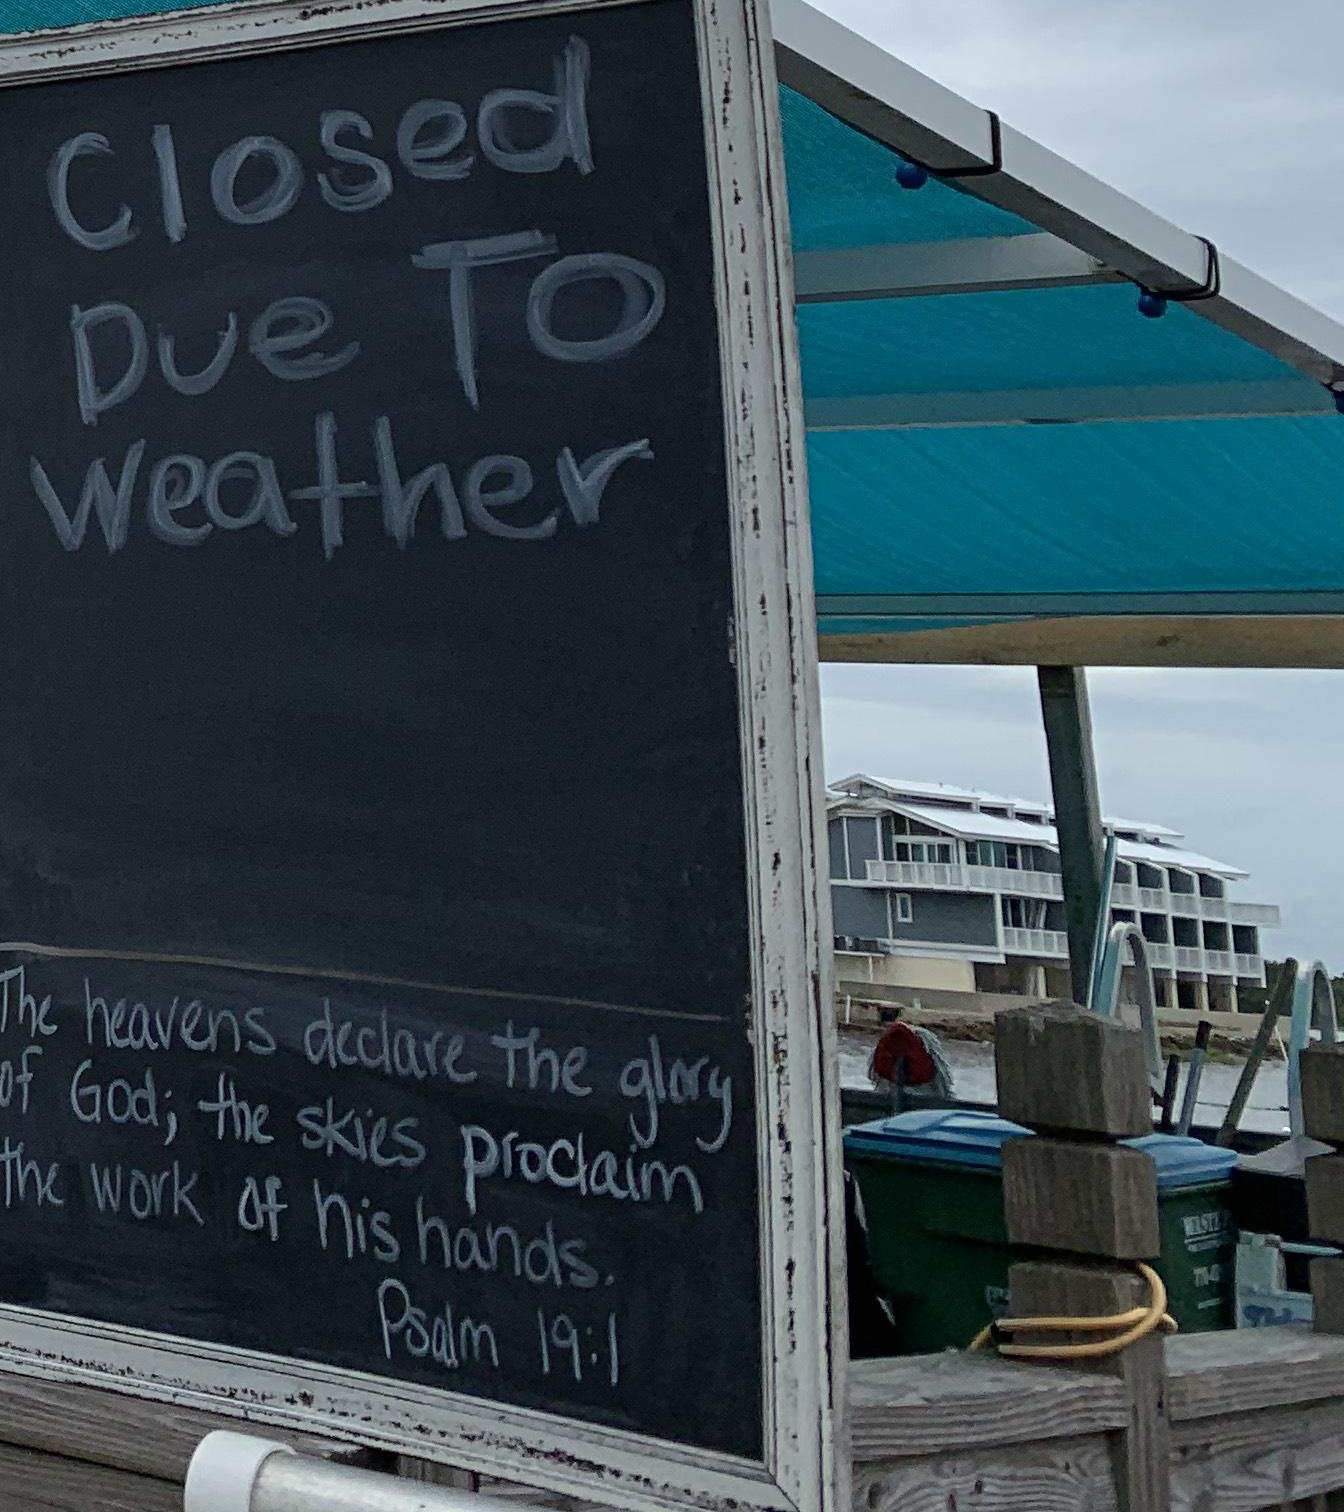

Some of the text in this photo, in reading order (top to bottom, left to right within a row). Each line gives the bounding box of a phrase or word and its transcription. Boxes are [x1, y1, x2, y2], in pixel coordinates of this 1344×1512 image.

[47, 35, 595, 250] Closed
[70, 295, 362, 426] Due
[70, 1059, 178, 1146] God;
[197, 1071, 275, 1144] the
[296, 1095, 427, 1167] skies
[460, 1123, 705, 1215] proclaim
[84, 977, 277, 1056] heavens
[303, 997, 478, 1084] declare
[490, 1019, 593, 1097] the
[619, 1034, 732, 1154] glory
[90, 1160, 205, 1226] work
[237, 1175, 289, 1242] of
[314, 1177, 401, 1263] his
[416, 1193, 615, 1289] hands.
[377, 1277, 618, 1385] Psalm 19:1
